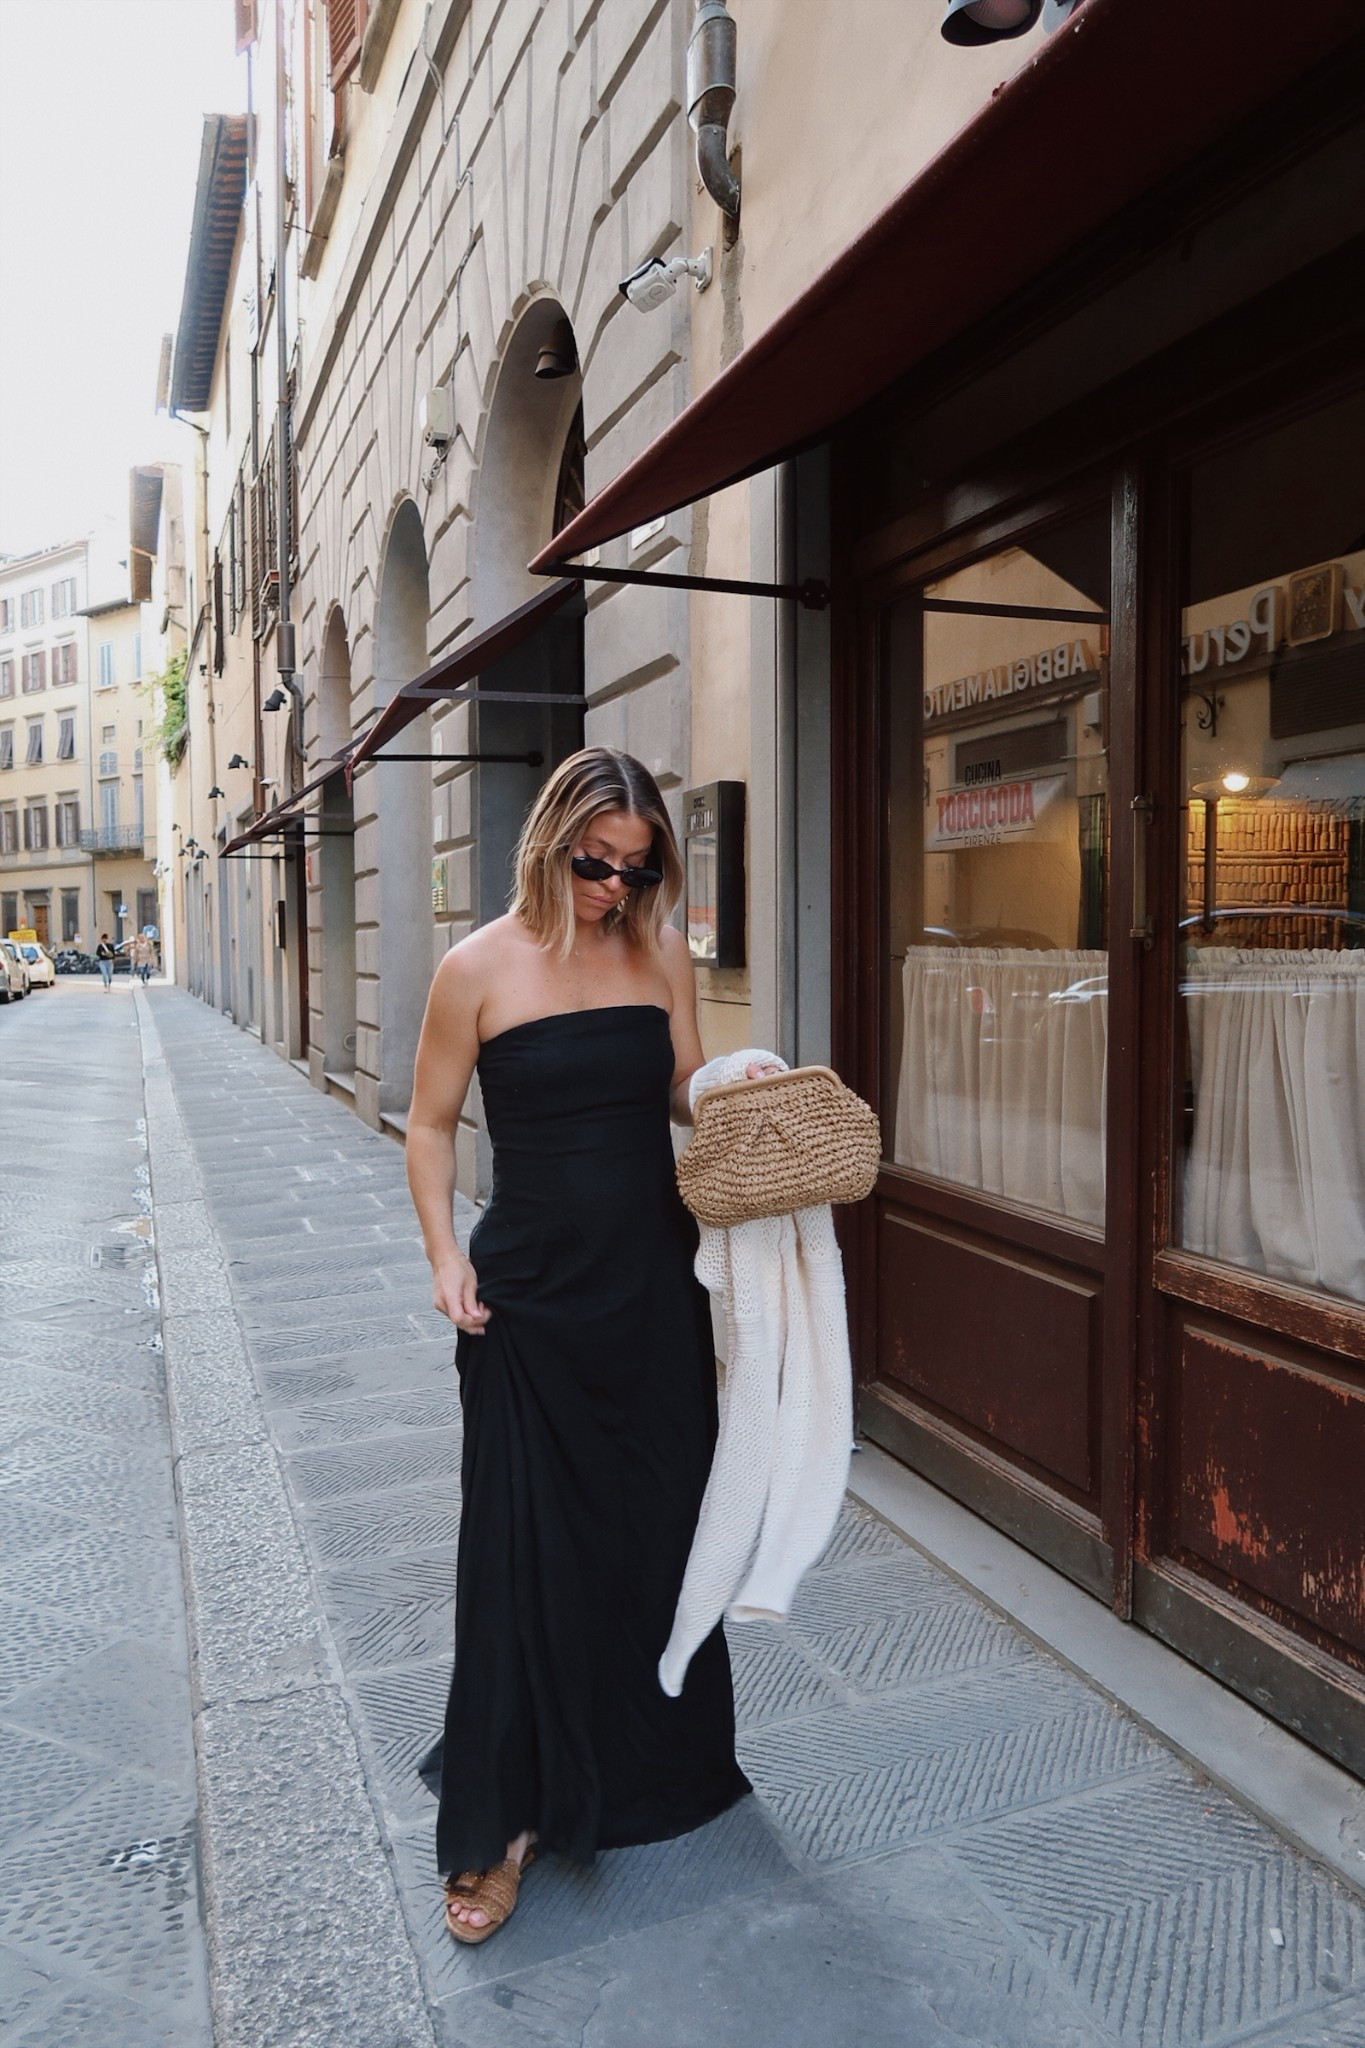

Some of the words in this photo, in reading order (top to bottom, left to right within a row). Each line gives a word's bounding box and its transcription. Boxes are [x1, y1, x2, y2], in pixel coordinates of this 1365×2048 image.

[964, 759, 1002, 786] CUCINA
[936, 780, 1036, 835] TORCICODA
[964, 831, 1002, 848] FIRENZE
